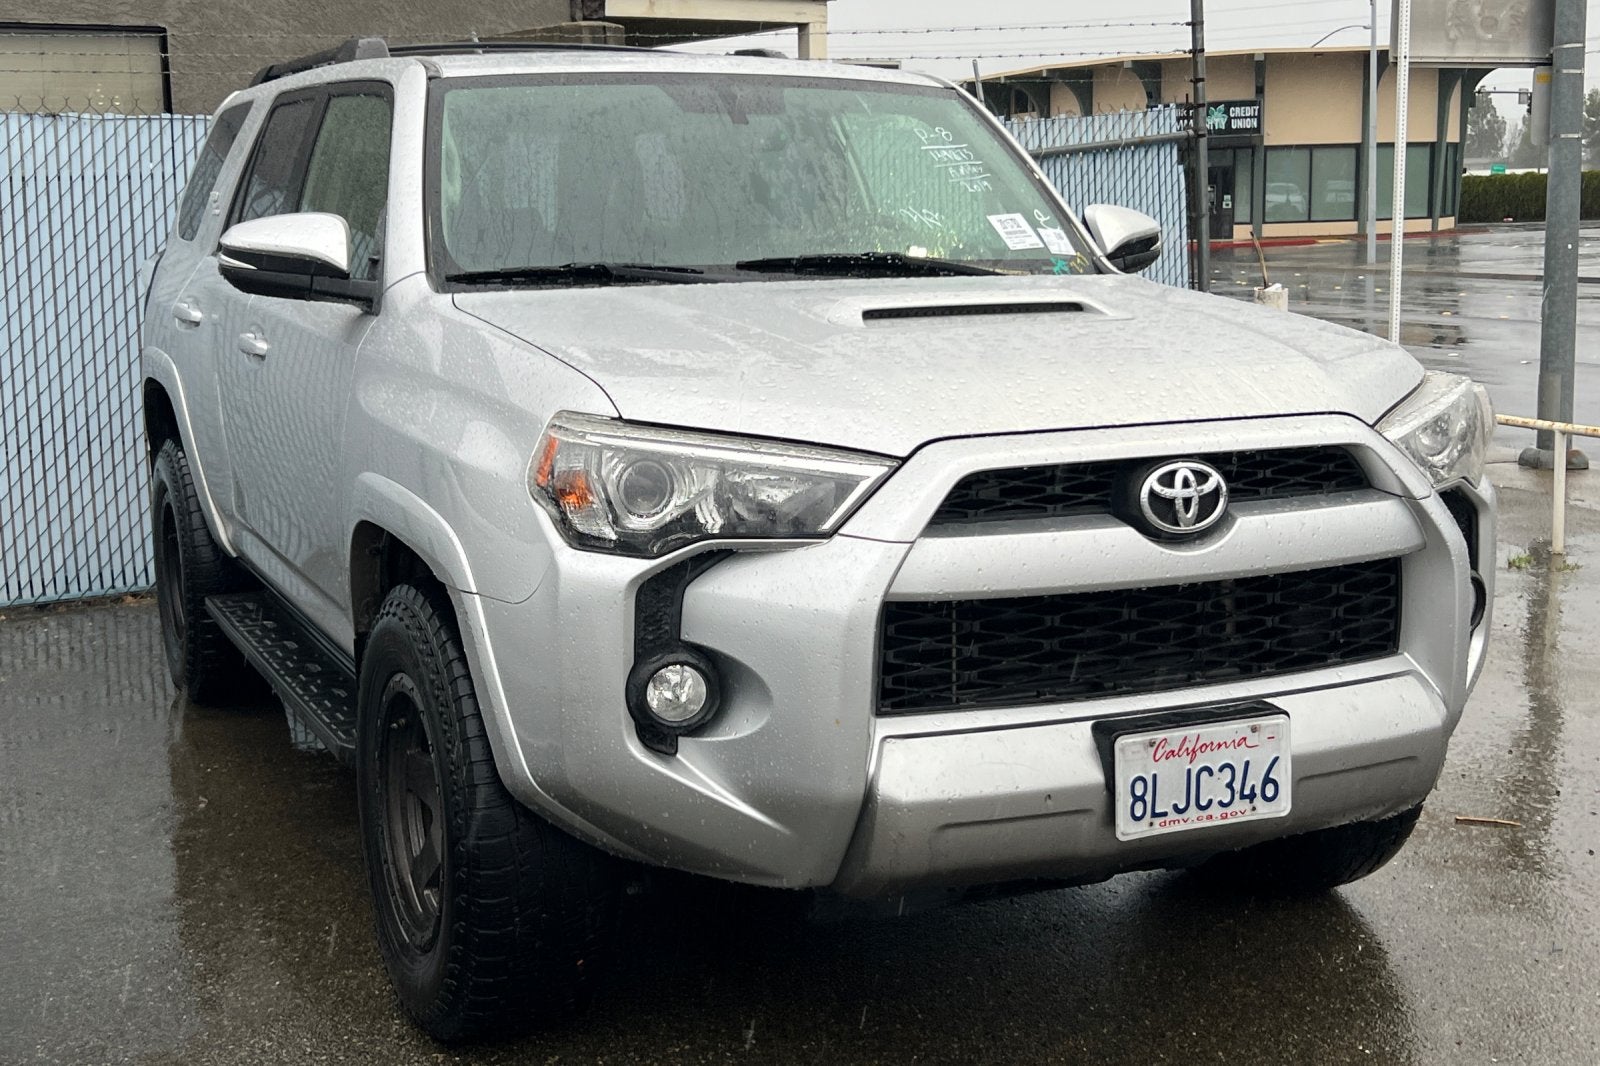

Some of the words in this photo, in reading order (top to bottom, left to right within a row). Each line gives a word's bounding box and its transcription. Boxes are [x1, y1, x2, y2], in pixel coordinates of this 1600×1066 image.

[1229, 106, 1259, 117] CREDIT
[1231, 118, 1258, 129] UNION
[1152, 734, 1260, 764] California
[1130, 755, 1280, 821] 8LJC346
[1158, 808, 1247, 828] dmv.ca.gov
